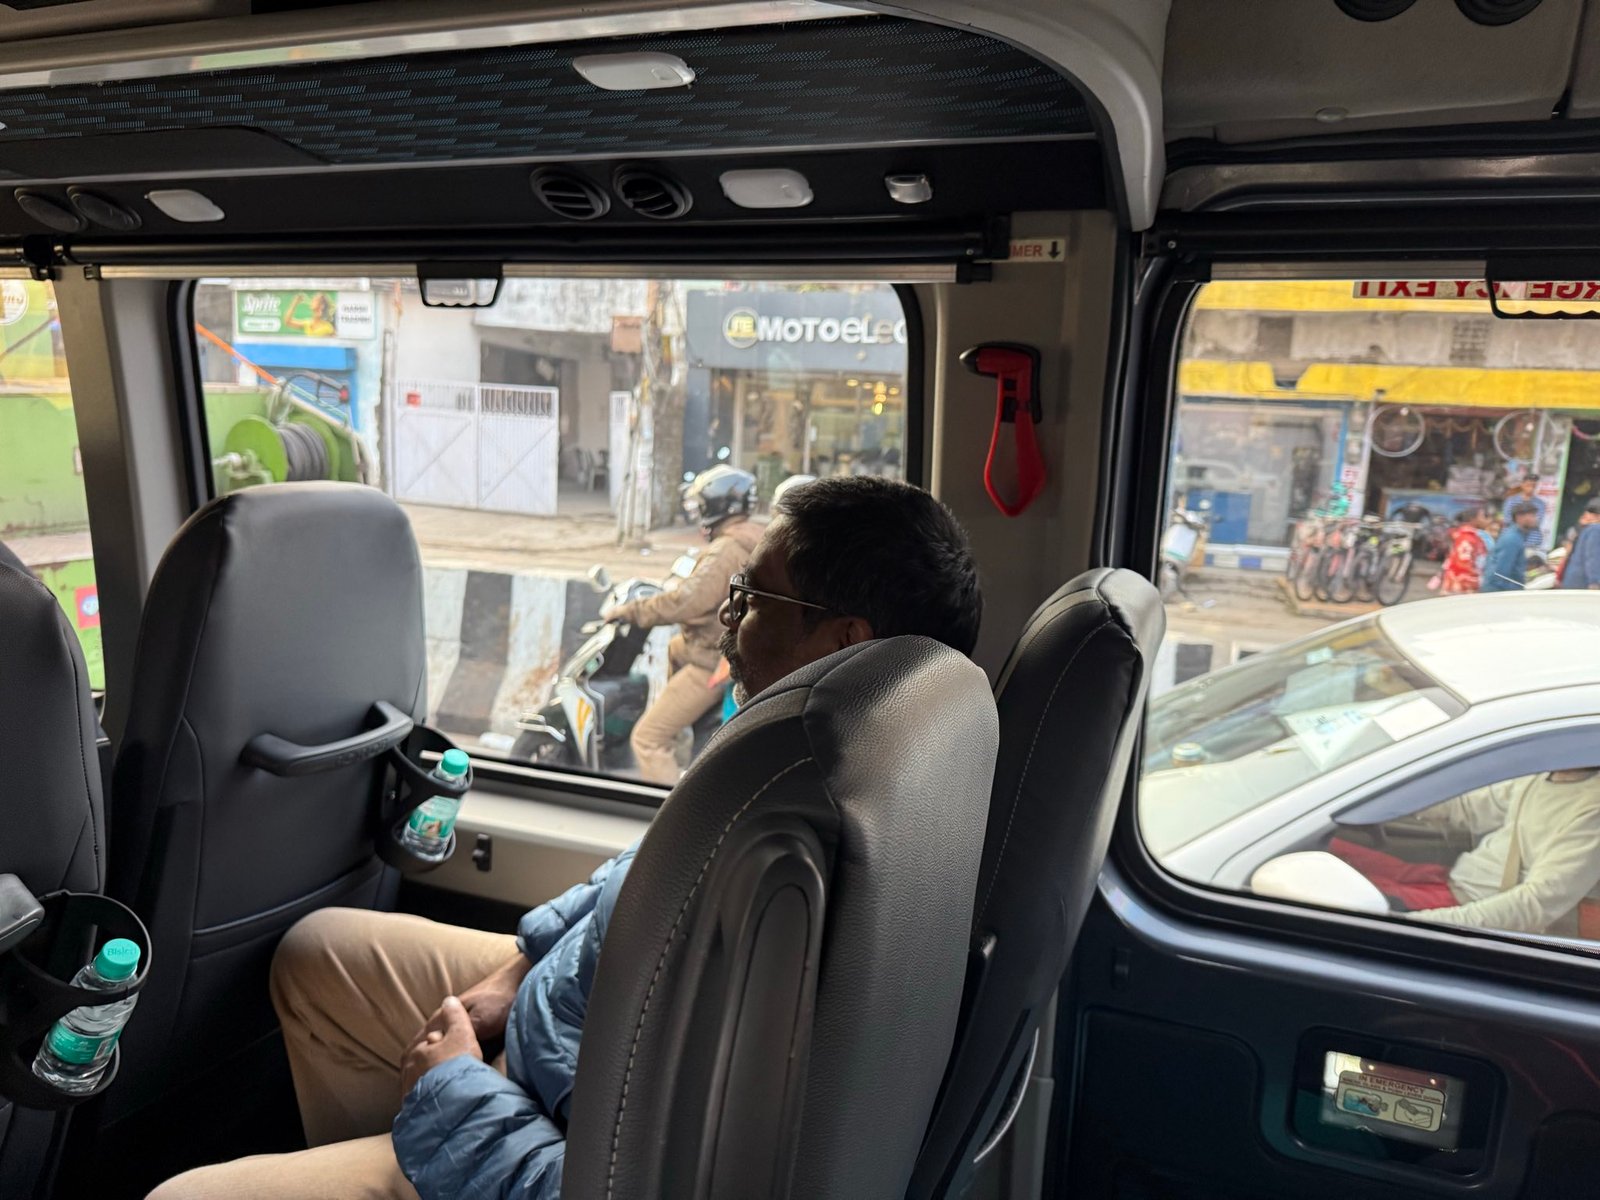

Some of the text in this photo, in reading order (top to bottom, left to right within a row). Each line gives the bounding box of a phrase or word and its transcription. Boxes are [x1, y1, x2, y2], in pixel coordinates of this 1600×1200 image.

[242, 293, 281, 314] Sprite
[1358, 1074, 1369, 1084] IN
[1369, 1077, 1425, 1095] EMERGENCY
